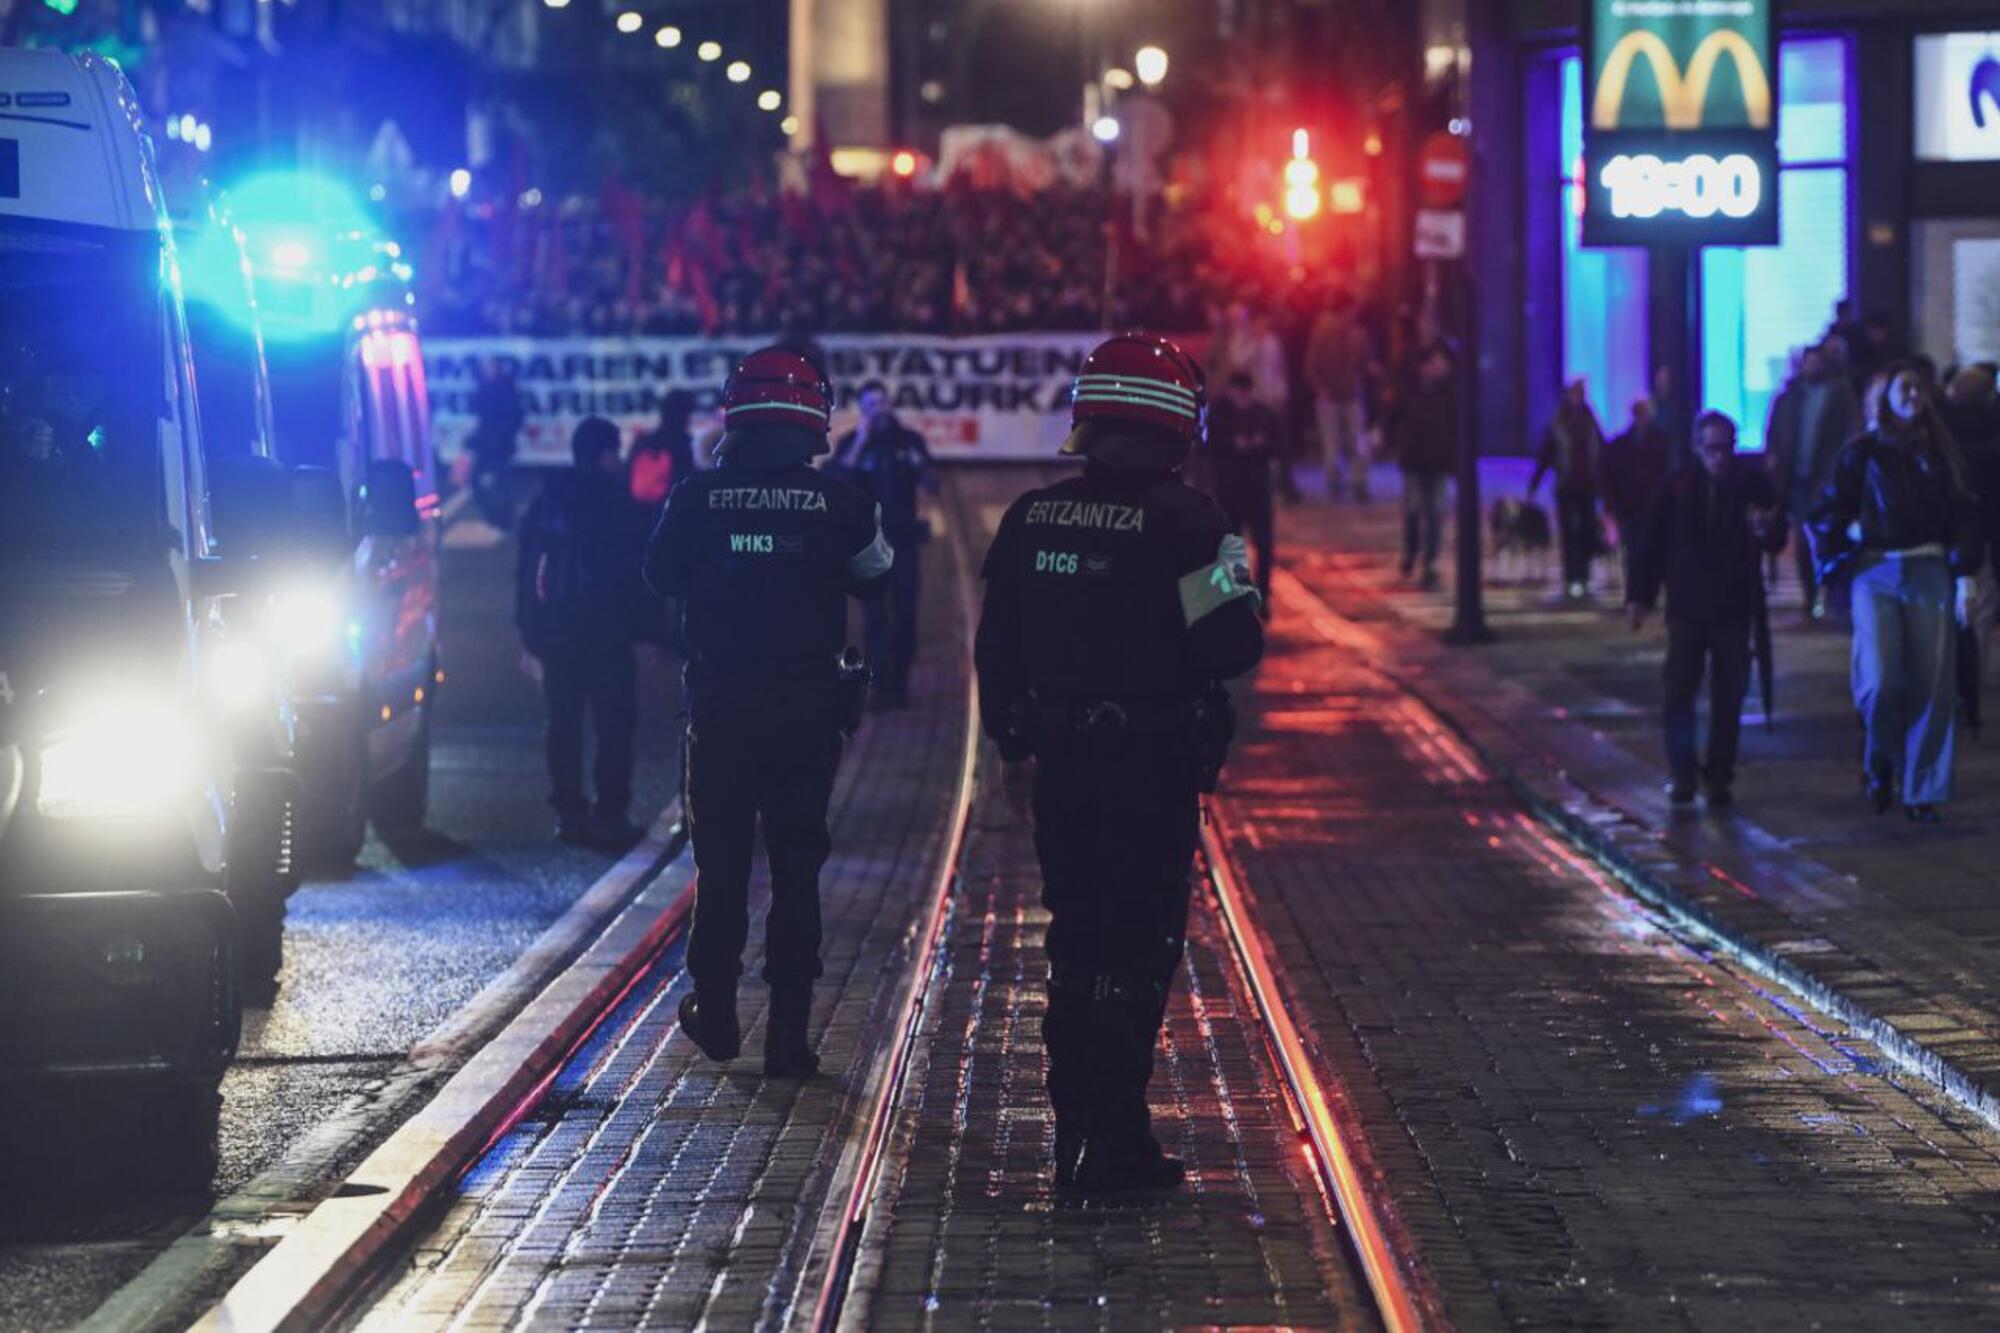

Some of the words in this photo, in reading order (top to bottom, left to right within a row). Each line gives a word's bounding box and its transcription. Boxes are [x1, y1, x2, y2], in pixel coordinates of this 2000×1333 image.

[708, 487, 828, 512] ERTZAINTZA
[1026, 501, 1145, 532] ERTZAINTZA
[730, 534, 774, 553] W1K3
[1036, 550, 1079, 574] D1C6
